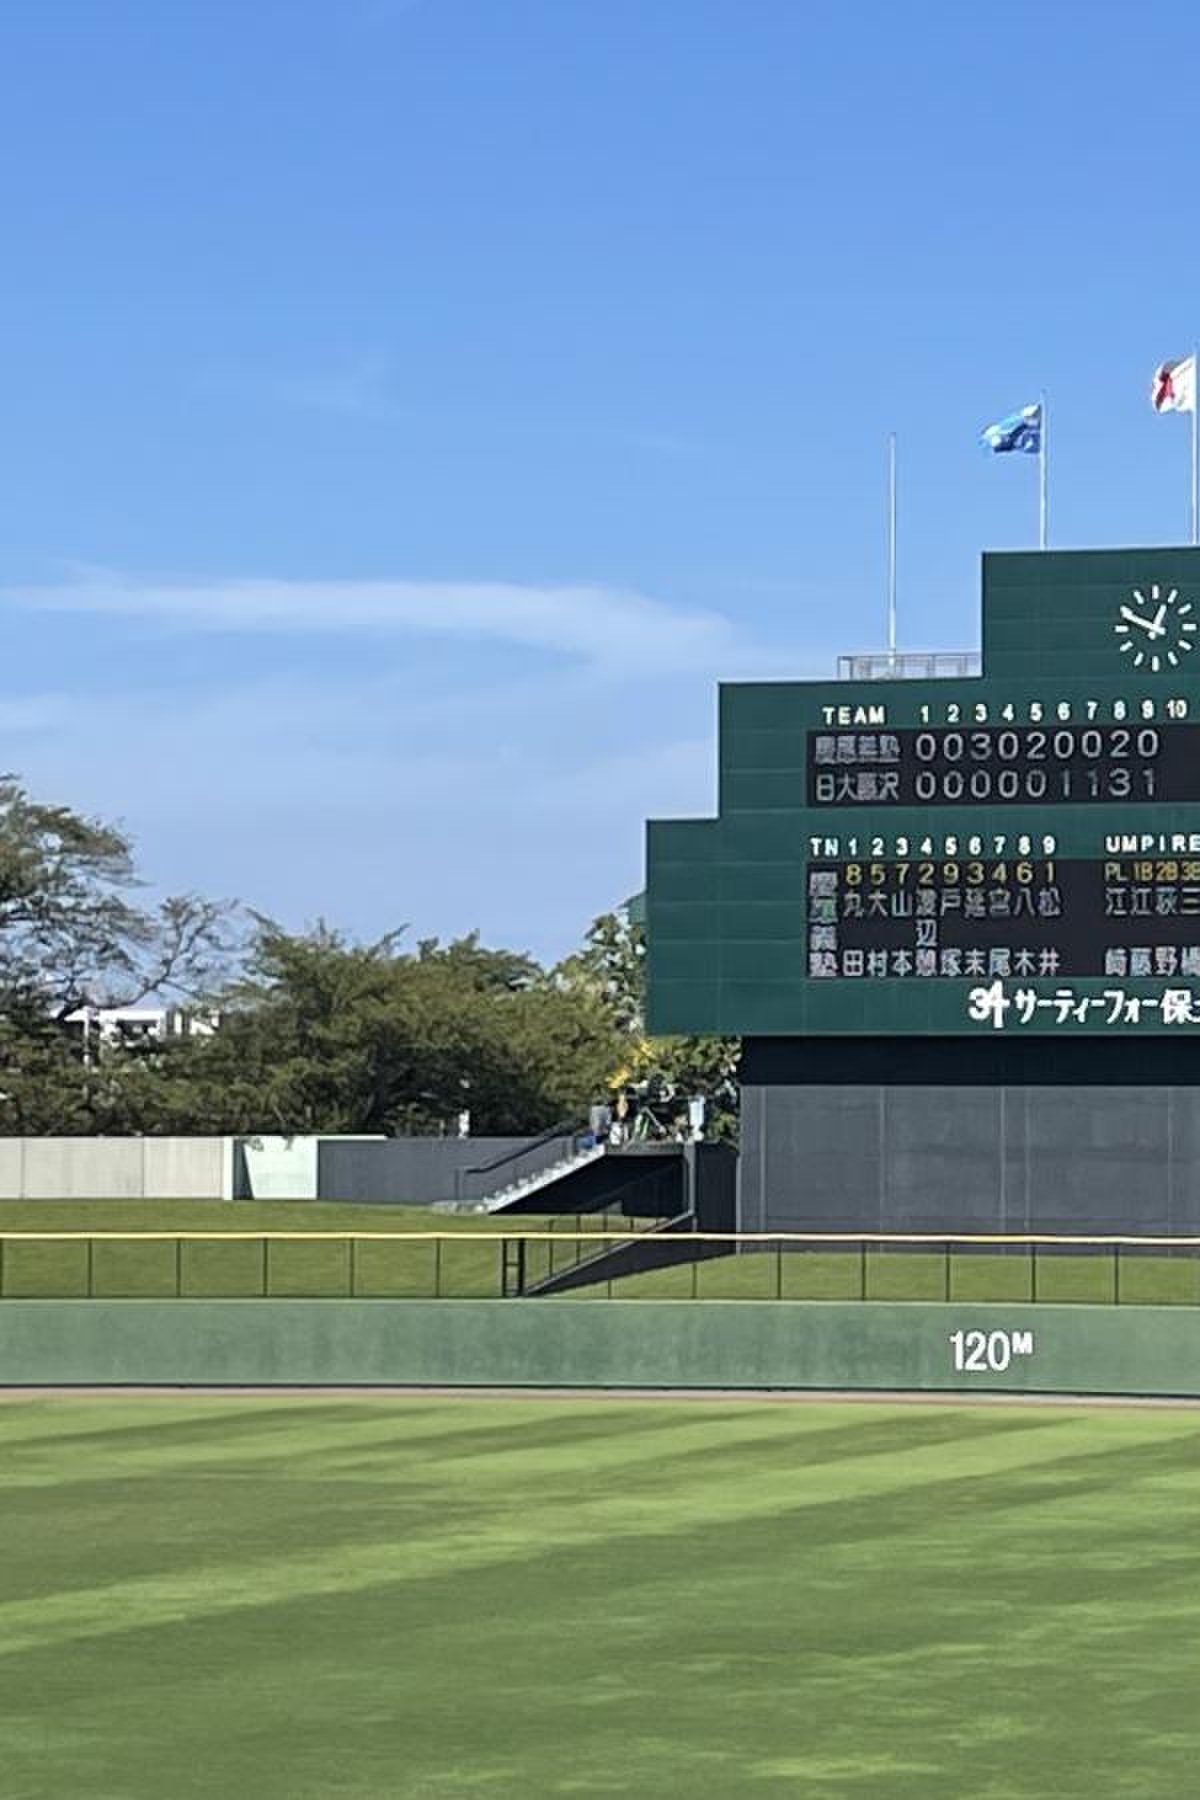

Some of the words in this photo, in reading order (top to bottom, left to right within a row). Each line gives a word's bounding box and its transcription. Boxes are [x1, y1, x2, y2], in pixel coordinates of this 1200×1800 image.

[823, 706, 884, 724] TEAM
[921, 706, 928, 722] 1
[948, 704, 958, 722] 2
[976, 704, 986, 722] 3
[1003, 704, 1013, 721] 4
[1031, 703, 1042, 721] 5
[1058, 703, 1069, 720] 6
[1088, 702, 1097, 720] 7
[1114, 701, 1125, 720] 8
[1142, 700, 1153, 718] 9
[1167, 700, 1186, 718] 10
[916, 734, 935, 760] 0
[944, 734, 963, 761] 0
[971, 733, 992, 759] 3
[999, 732, 1018, 759] 0
[1027, 732, 1045, 758] 2
[1054, 731, 1074, 758] 0
[1082, 731, 1101, 757] 0
[1110, 730, 1129, 757] 2
[1138, 730, 1158, 756] 0
[916, 772, 935, 799] 0
[944, 771, 963, 798] 0
[971, 770, 990, 798] 0
[999, 771, 1018, 798] 0
[1026, 770, 1046, 797] 0
[1064, 770, 1069, 796] 1
[1088, 771, 1097, 796] 1
[1109, 768, 1130, 796] 3
[1143, 768, 1153, 795] 1
[811, 838, 838, 856] TN
[849, 838, 856, 855] 1
[872, 838, 883, 855] 2
[896, 838, 907, 855] 3
[921, 838, 931, 854] 4
[946, 837, 956, 855] 5
[969, 837, 981, 855] 6
[994, 836, 1005, 854] 7
[1019, 836, 1030, 855] 8
[1043, 836, 1055, 854] 9
[846, 864, 861, 885] 8
[871, 864, 885, 884] 5
[896, 864, 909, 884] 7
[919, 864, 934, 884] 2
[944, 863, 958, 883] 9
[967, 862, 984, 884] 3
[993, 862, 1006, 882] 4
[1017, 862, 1032, 883] 6
[1047, 862, 1053, 882] 1
[1105, 862, 1128, 881] PL
[843, 889, 864, 976] 丸田
[867, 889, 888, 976] 大村
[891, 889, 913, 976] 山本
[1013, 888, 1036, 976] 八木
[1038, 887, 1061, 976] 松井
